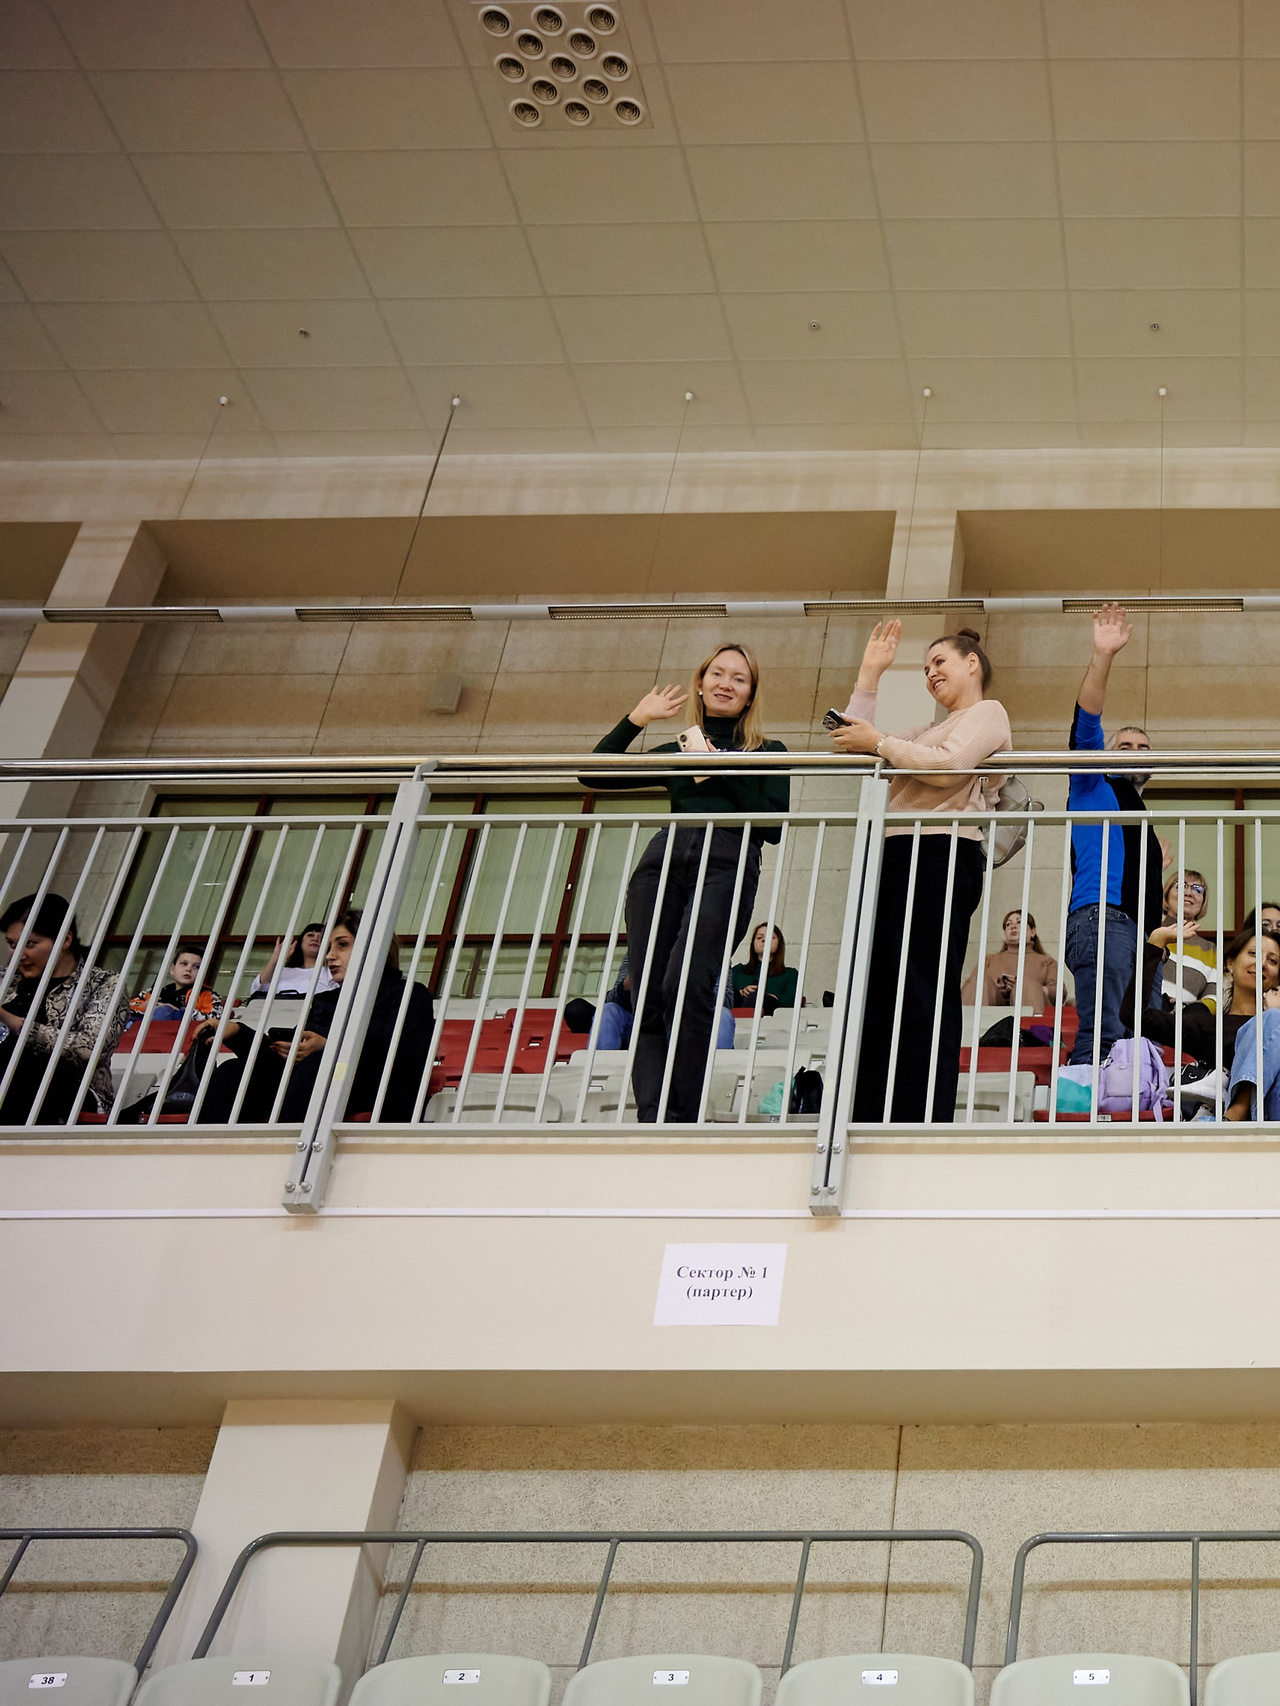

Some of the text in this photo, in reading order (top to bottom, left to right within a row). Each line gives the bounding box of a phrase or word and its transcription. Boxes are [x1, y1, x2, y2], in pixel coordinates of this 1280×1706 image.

[677, 1265, 768, 1281] Сектор № 1
[686, 1285, 753, 1300] (партер)
[41, 1676, 55, 1685] 38
[248, 1674, 255, 1682] 1
[458, 1672, 465, 1681] 2
[668, 1673, 675, 1681] 3
[876, 1673, 883, 1681] 4
[1088, 1673, 1095, 1681] 5
